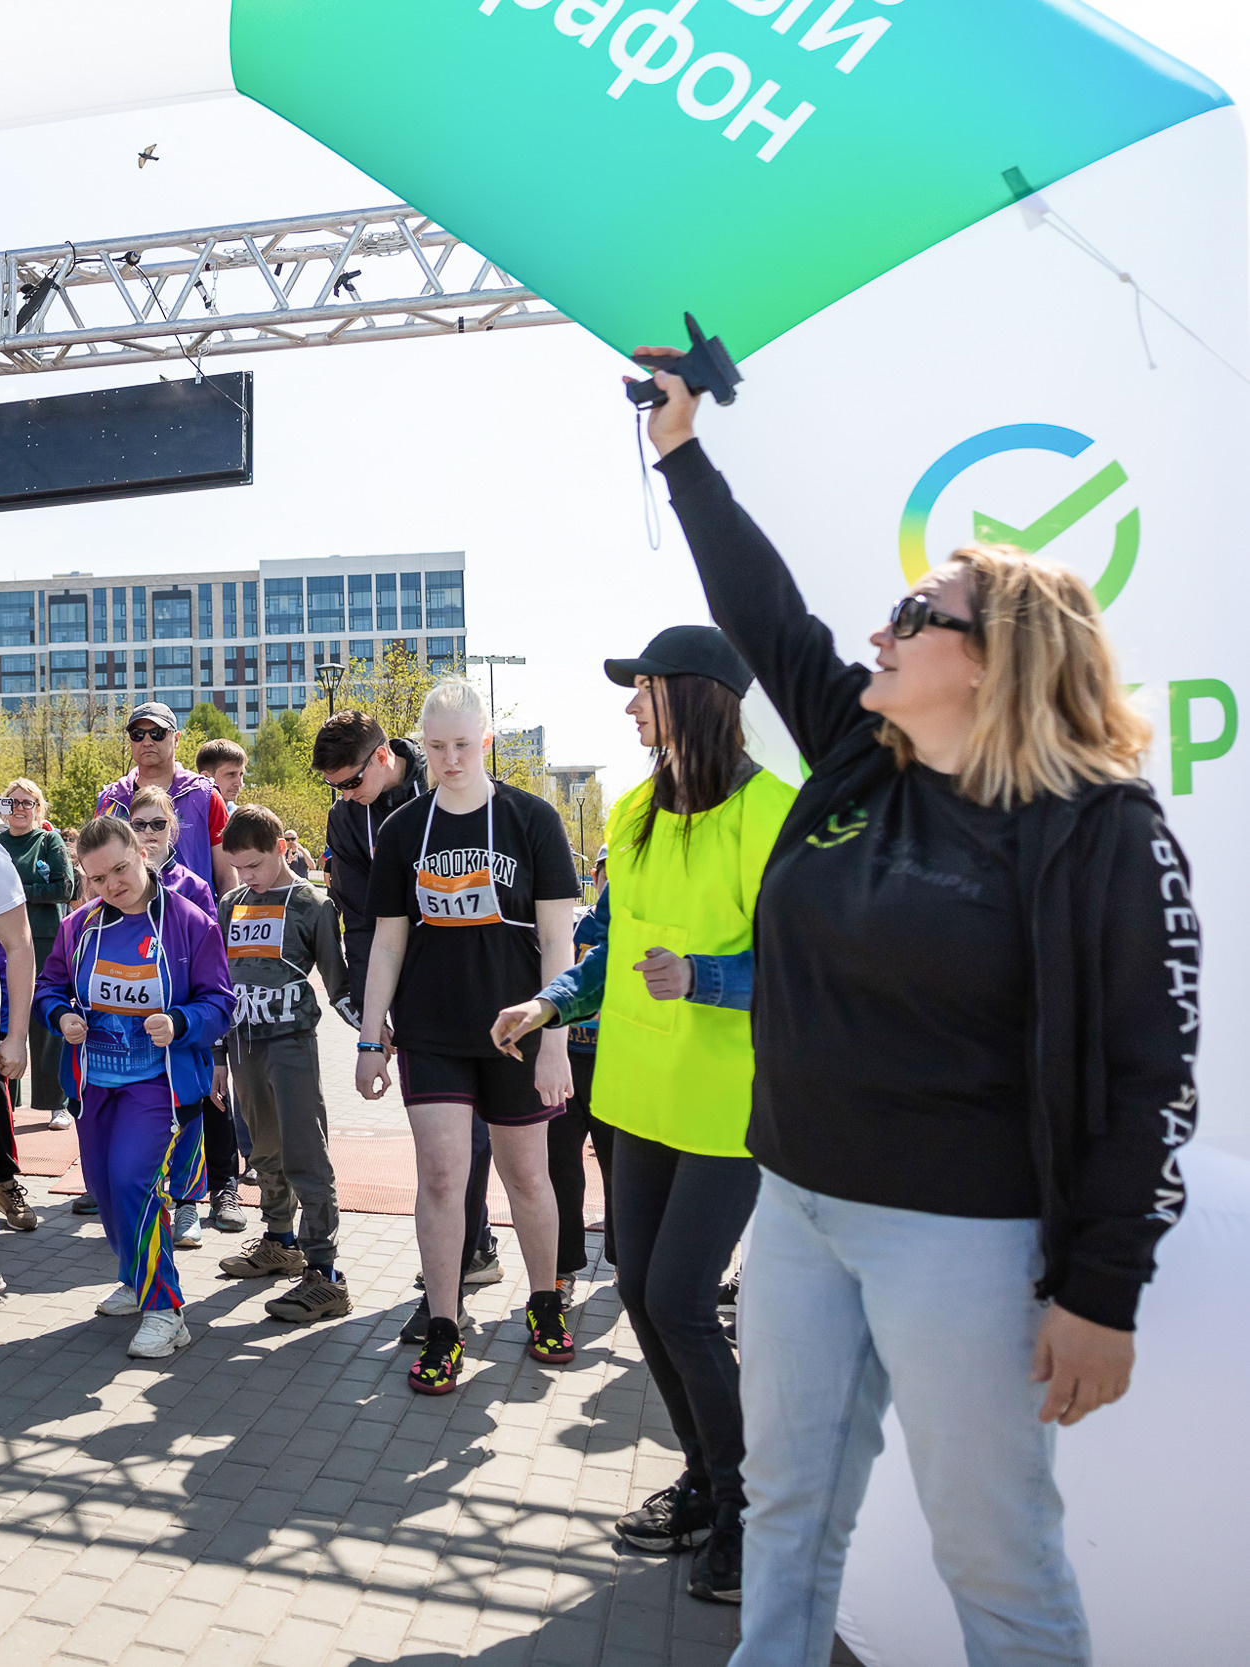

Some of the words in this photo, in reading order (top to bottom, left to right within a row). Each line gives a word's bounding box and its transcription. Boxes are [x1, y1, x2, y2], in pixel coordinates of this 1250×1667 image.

[426, 893, 480, 916] 5117
[230, 923, 272, 942] 5120
[99, 981, 150, 1005] 5146
